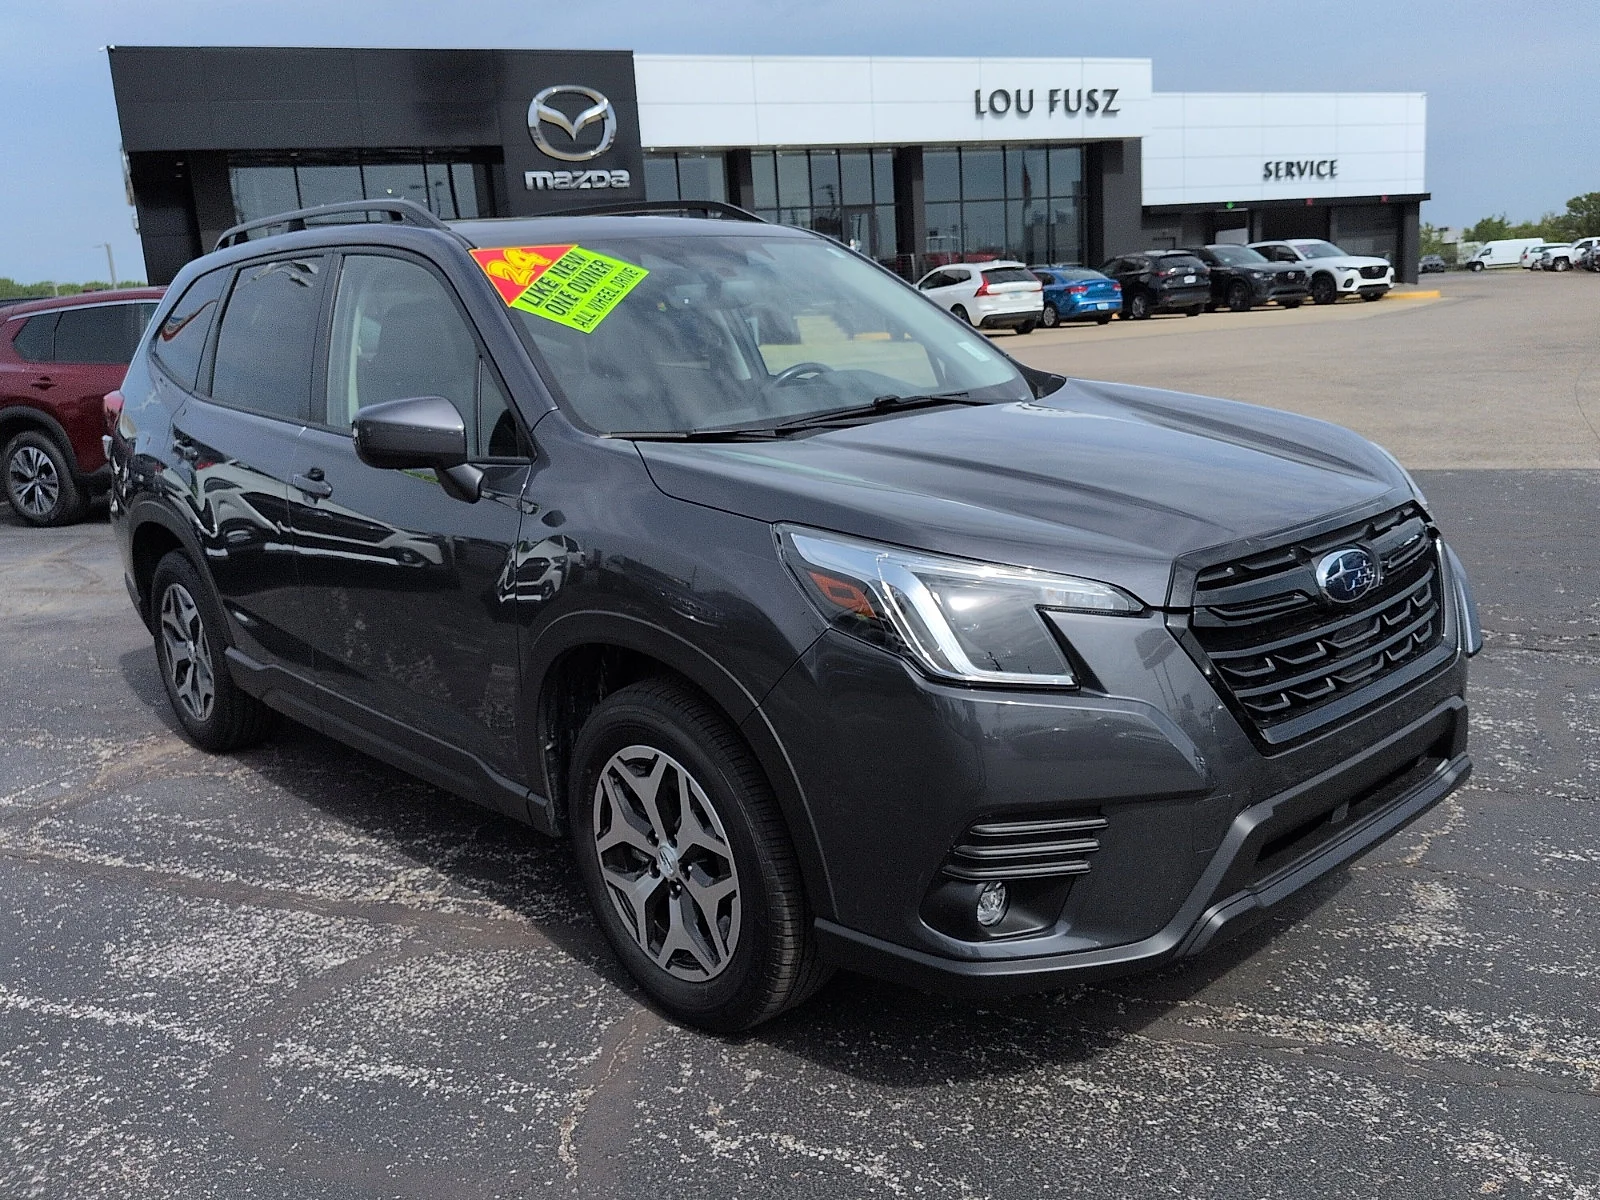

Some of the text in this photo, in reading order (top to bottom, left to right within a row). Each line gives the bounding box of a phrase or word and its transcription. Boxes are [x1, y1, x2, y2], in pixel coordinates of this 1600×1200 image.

[974, 88, 1121, 116] LOU FUSZ
[1263, 159, 1338, 179] SERVICE
[486, 248, 553, 286] 24
[519, 252, 589, 307] LIKE NEW
[545, 259, 614, 316] ONE OWNER
[572, 267, 639, 328] ALL WHEEL DRIVE
